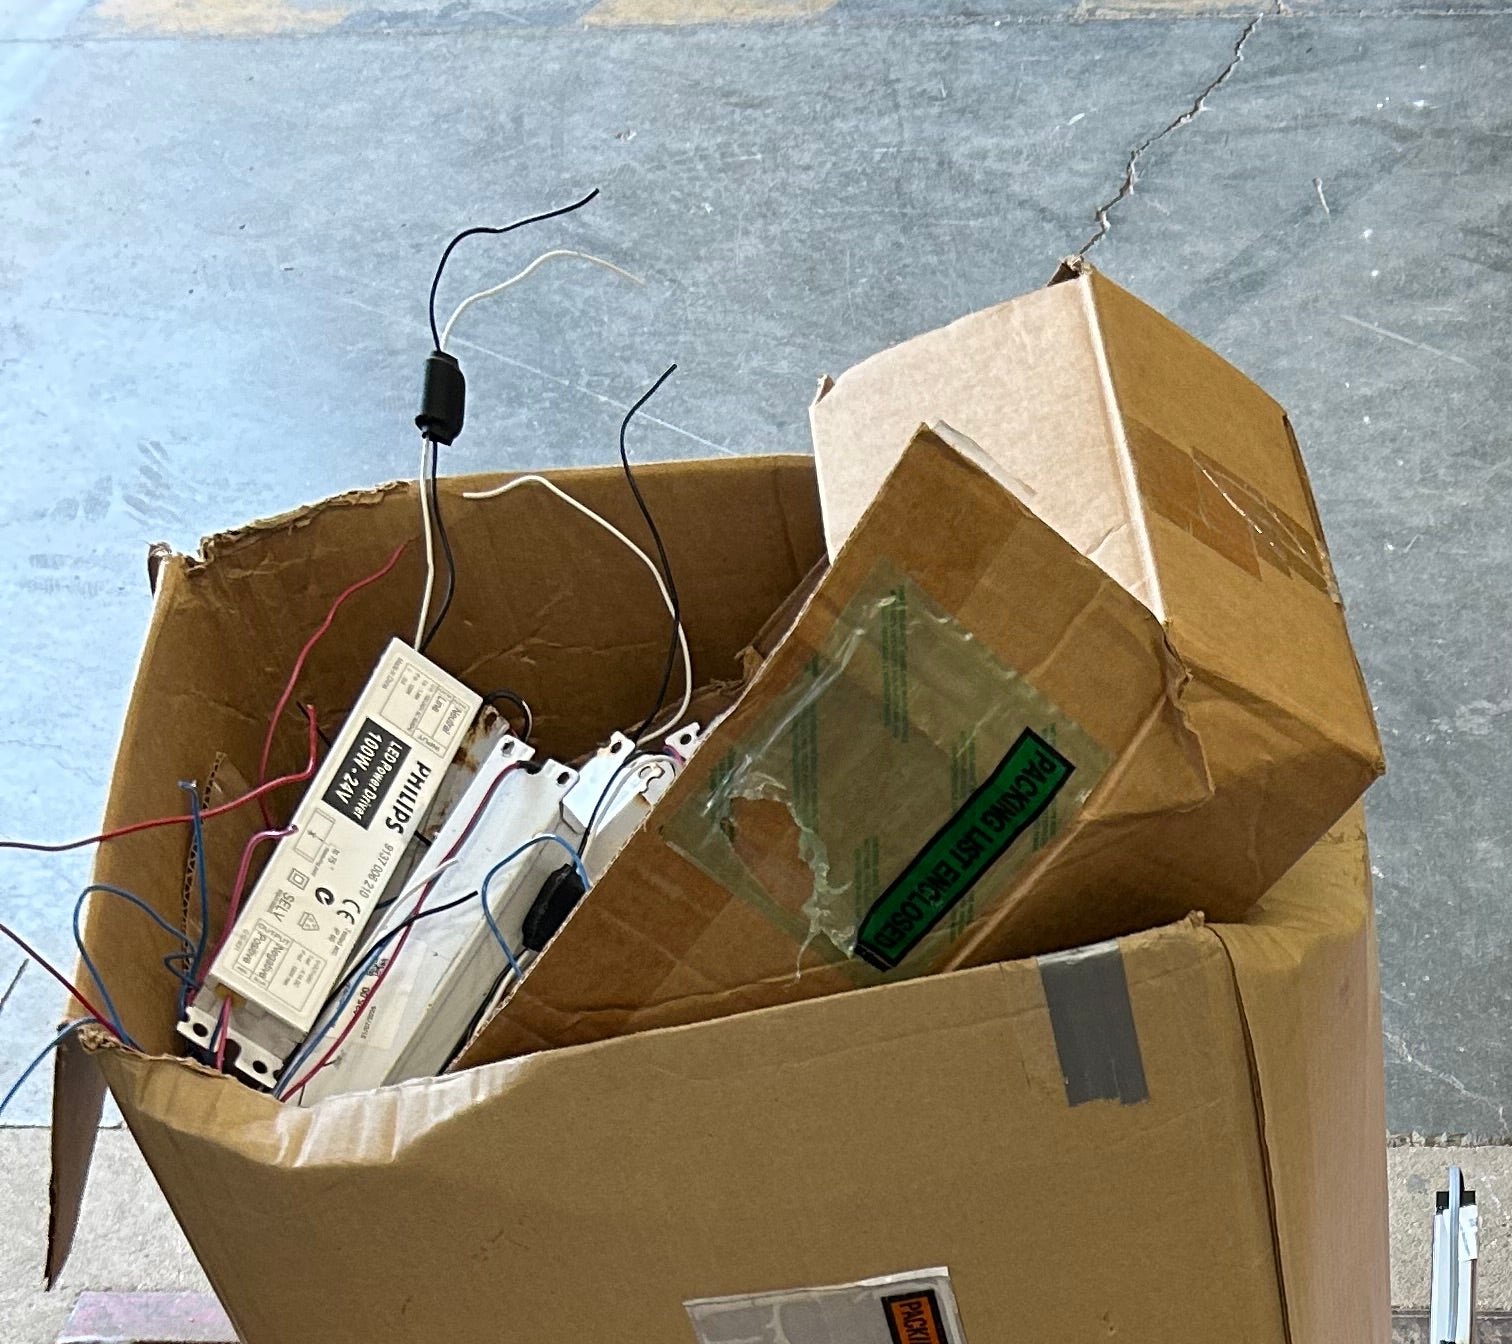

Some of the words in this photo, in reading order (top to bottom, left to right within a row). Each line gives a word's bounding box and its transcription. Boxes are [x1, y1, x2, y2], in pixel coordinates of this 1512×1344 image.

[431, 695, 446, 713] Line
[440, 705, 461, 735] Neutral
[351, 729, 384, 771] 100W
[382, 740, 403, 765] LED
[333, 772, 359, 804] 24V
[366, 759, 392, 791] Power
[979, 749, 1058, 835] PACKING
[350, 787, 376, 821] Driver
[383, 759, 431, 835] PHILIPS
[946, 824, 994, 871] LIST
[272, 891, 295, 922] SELV
[873, 858, 962, 955] ENCLOSED
[241, 931, 266, 965] Positive
[256, 941, 284, 980] Negative
